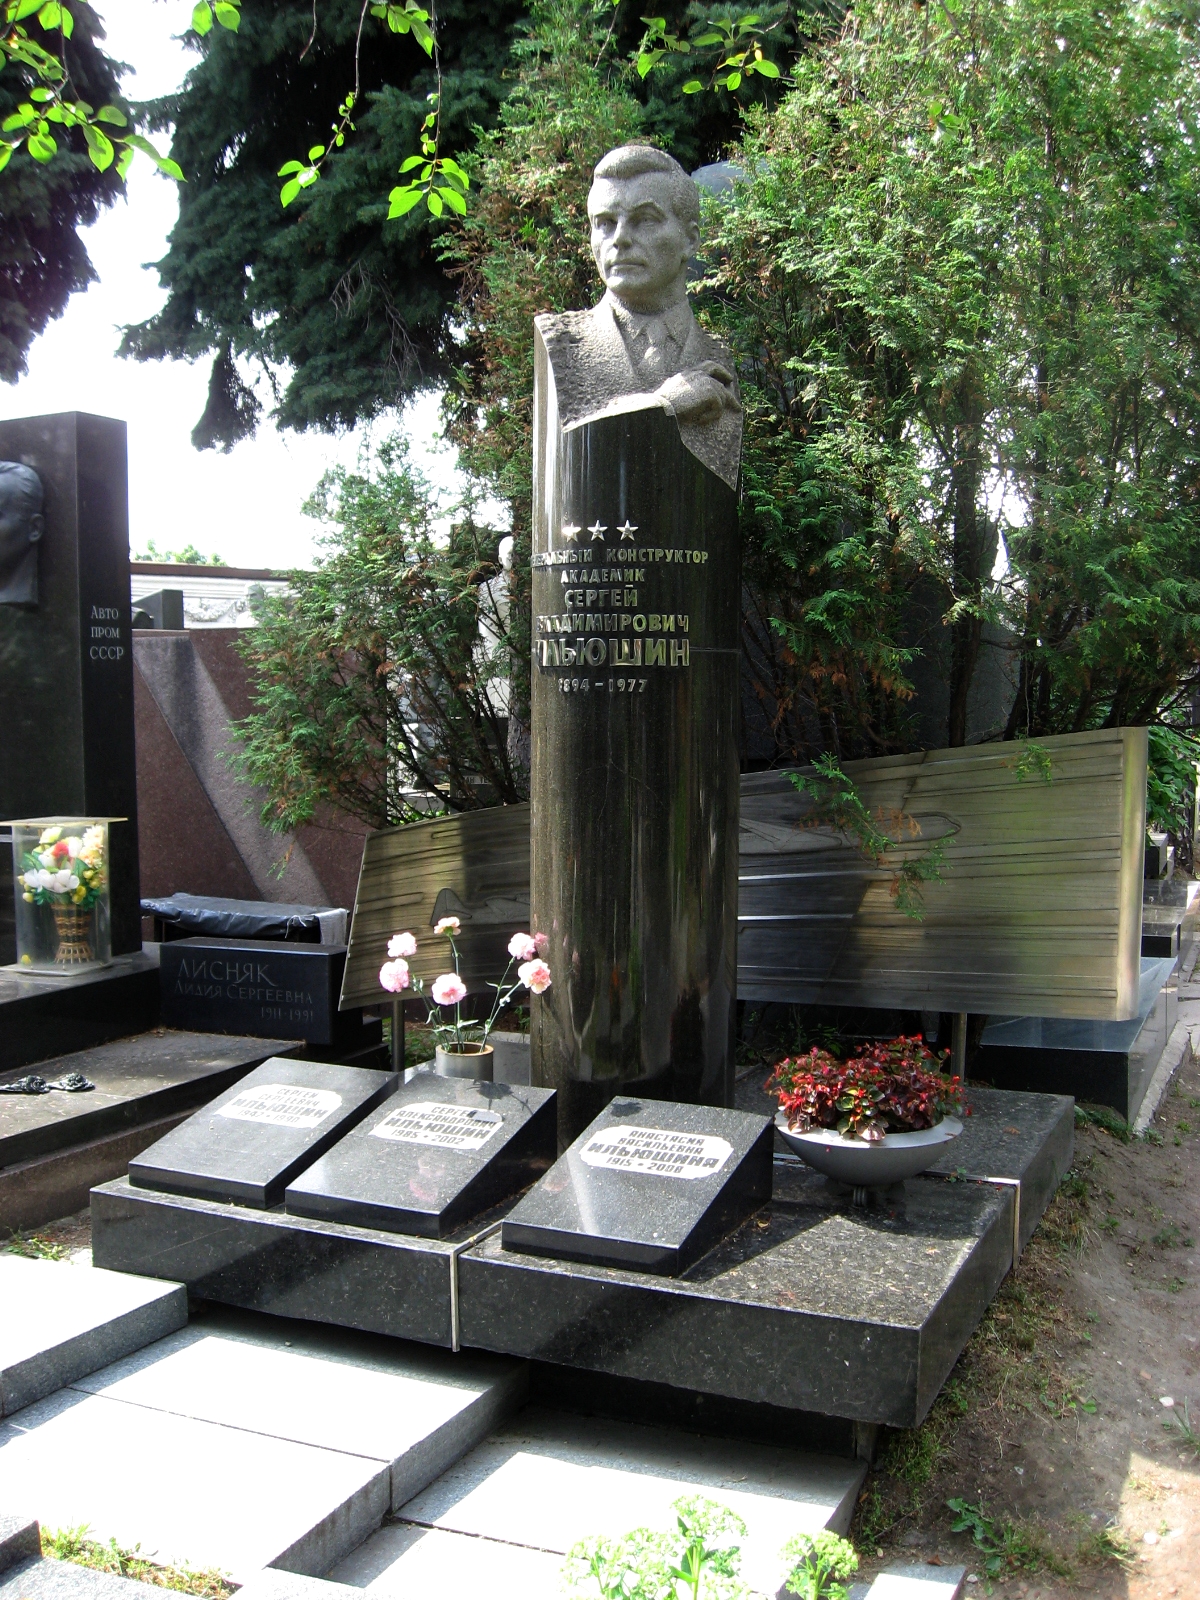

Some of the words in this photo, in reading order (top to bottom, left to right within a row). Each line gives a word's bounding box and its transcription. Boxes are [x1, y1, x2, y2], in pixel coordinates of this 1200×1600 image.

[606, 548, 709, 563] КОНСТРУКТОР
[560, 568, 645, 584] АКАДЕМИК
[564, 584, 638, 607] СЕРГЕЙ
[535, 613, 689, 633] ВЛАДИМИРОВИЧ
[90, 645, 124, 660] СССР
[178, 958, 278, 987] ЛИСНЯК
[231, 1098, 330, 1119] ИЛЬЮШИН
[384, 1117, 492, 1139] ИЛЬЮШИН
[396, 1110, 497, 1129] АЛЕКСАНДРОВИЧ
[391, 1129, 421, 1139] 1985
[431, 1134, 466, 1145] 2002
[617, 1137, 704, 1155] ВАСИЛЬЕВНА
[629, 1130, 706, 1146] АНАСТАСИЯ
[587, 1142, 720, 1169] ИЛЬЮШИНА
[606, 1156, 632, 1167] 1915
